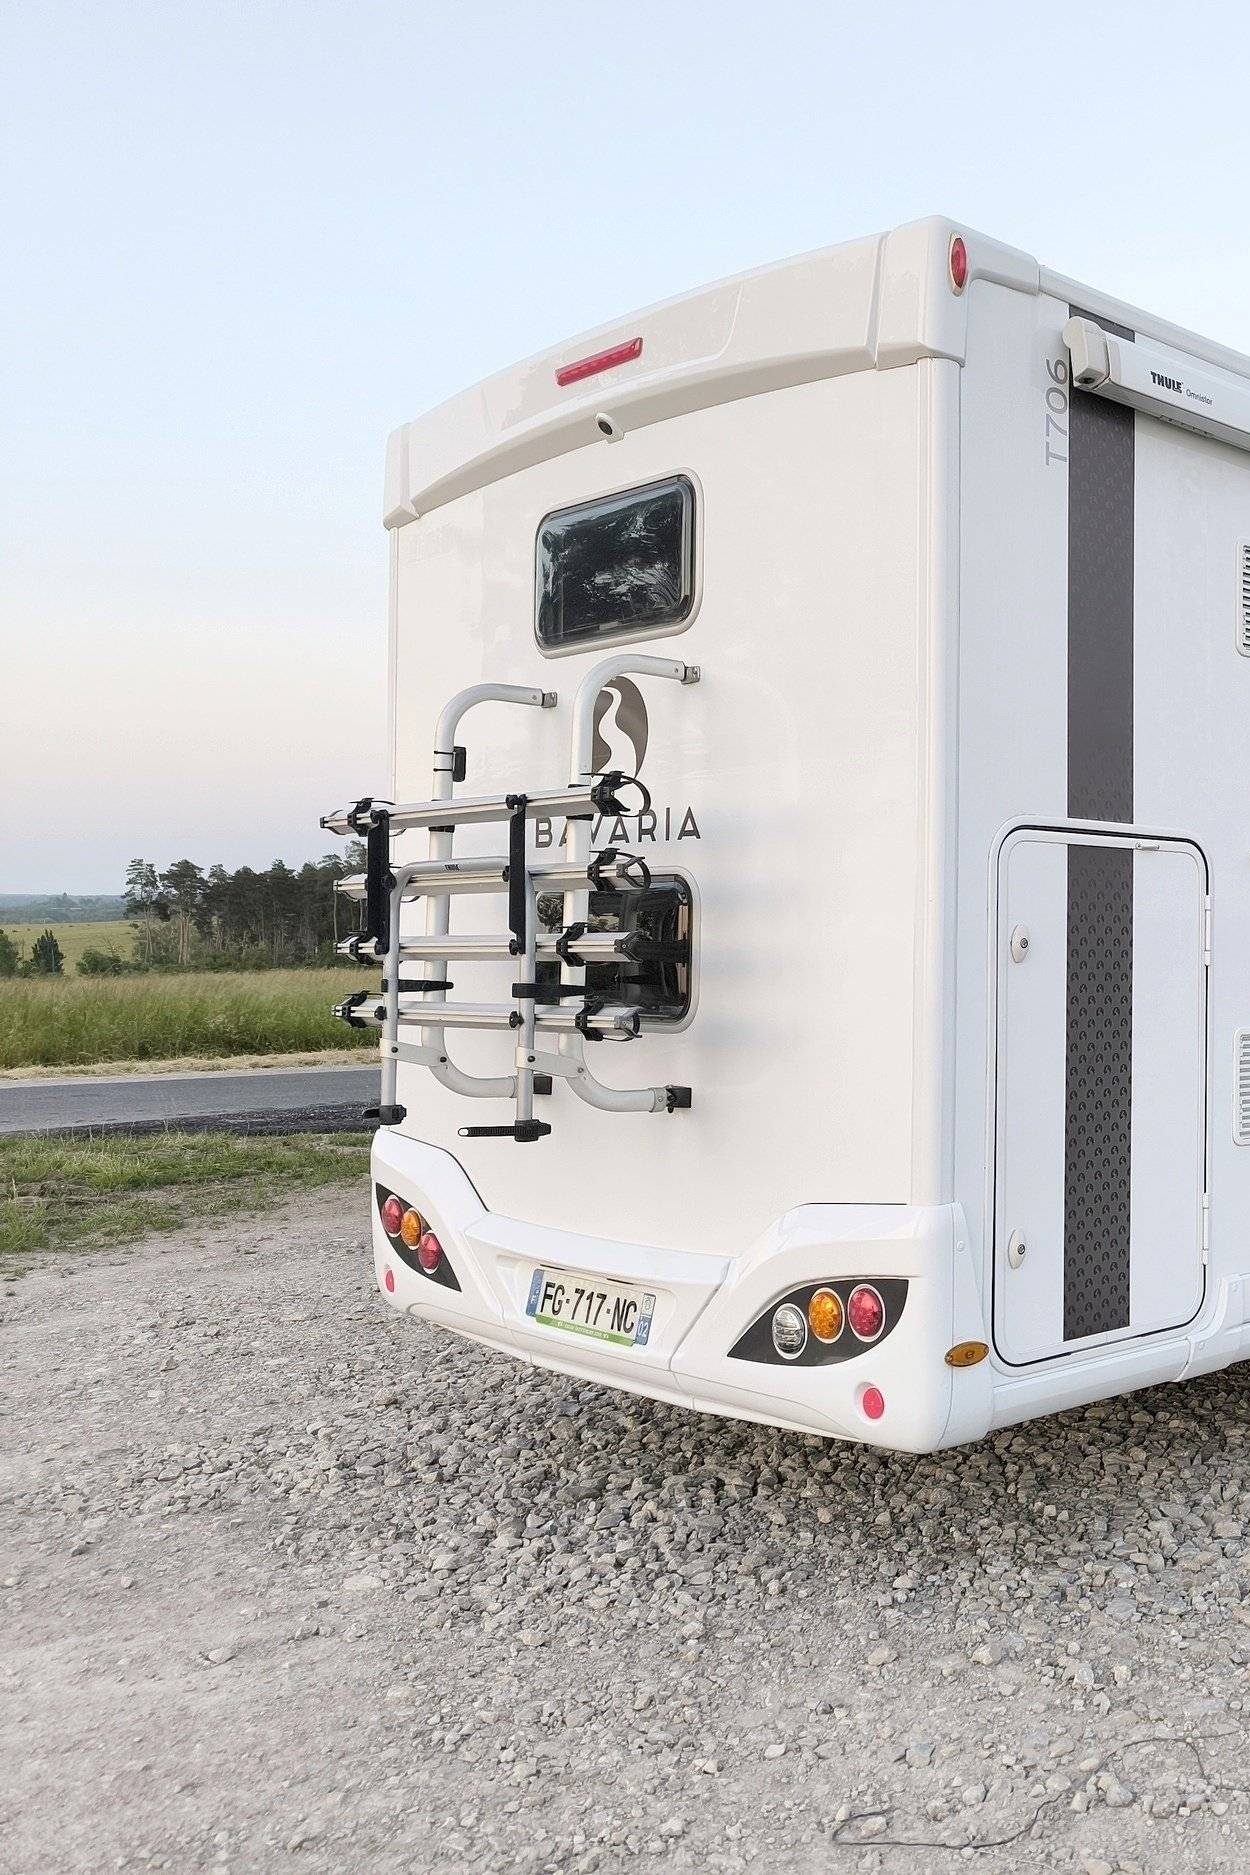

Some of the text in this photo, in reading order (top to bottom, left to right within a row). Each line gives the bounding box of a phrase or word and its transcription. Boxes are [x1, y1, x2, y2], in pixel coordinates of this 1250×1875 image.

[1150, 371, 1183, 394] THULE
[1045, 359, 1068, 466] T706
[535, 806, 701, 848] BVARIA
[540, 1281, 637, 1334] FG-717-NC
[638, 1320, 649, 1338] 02
